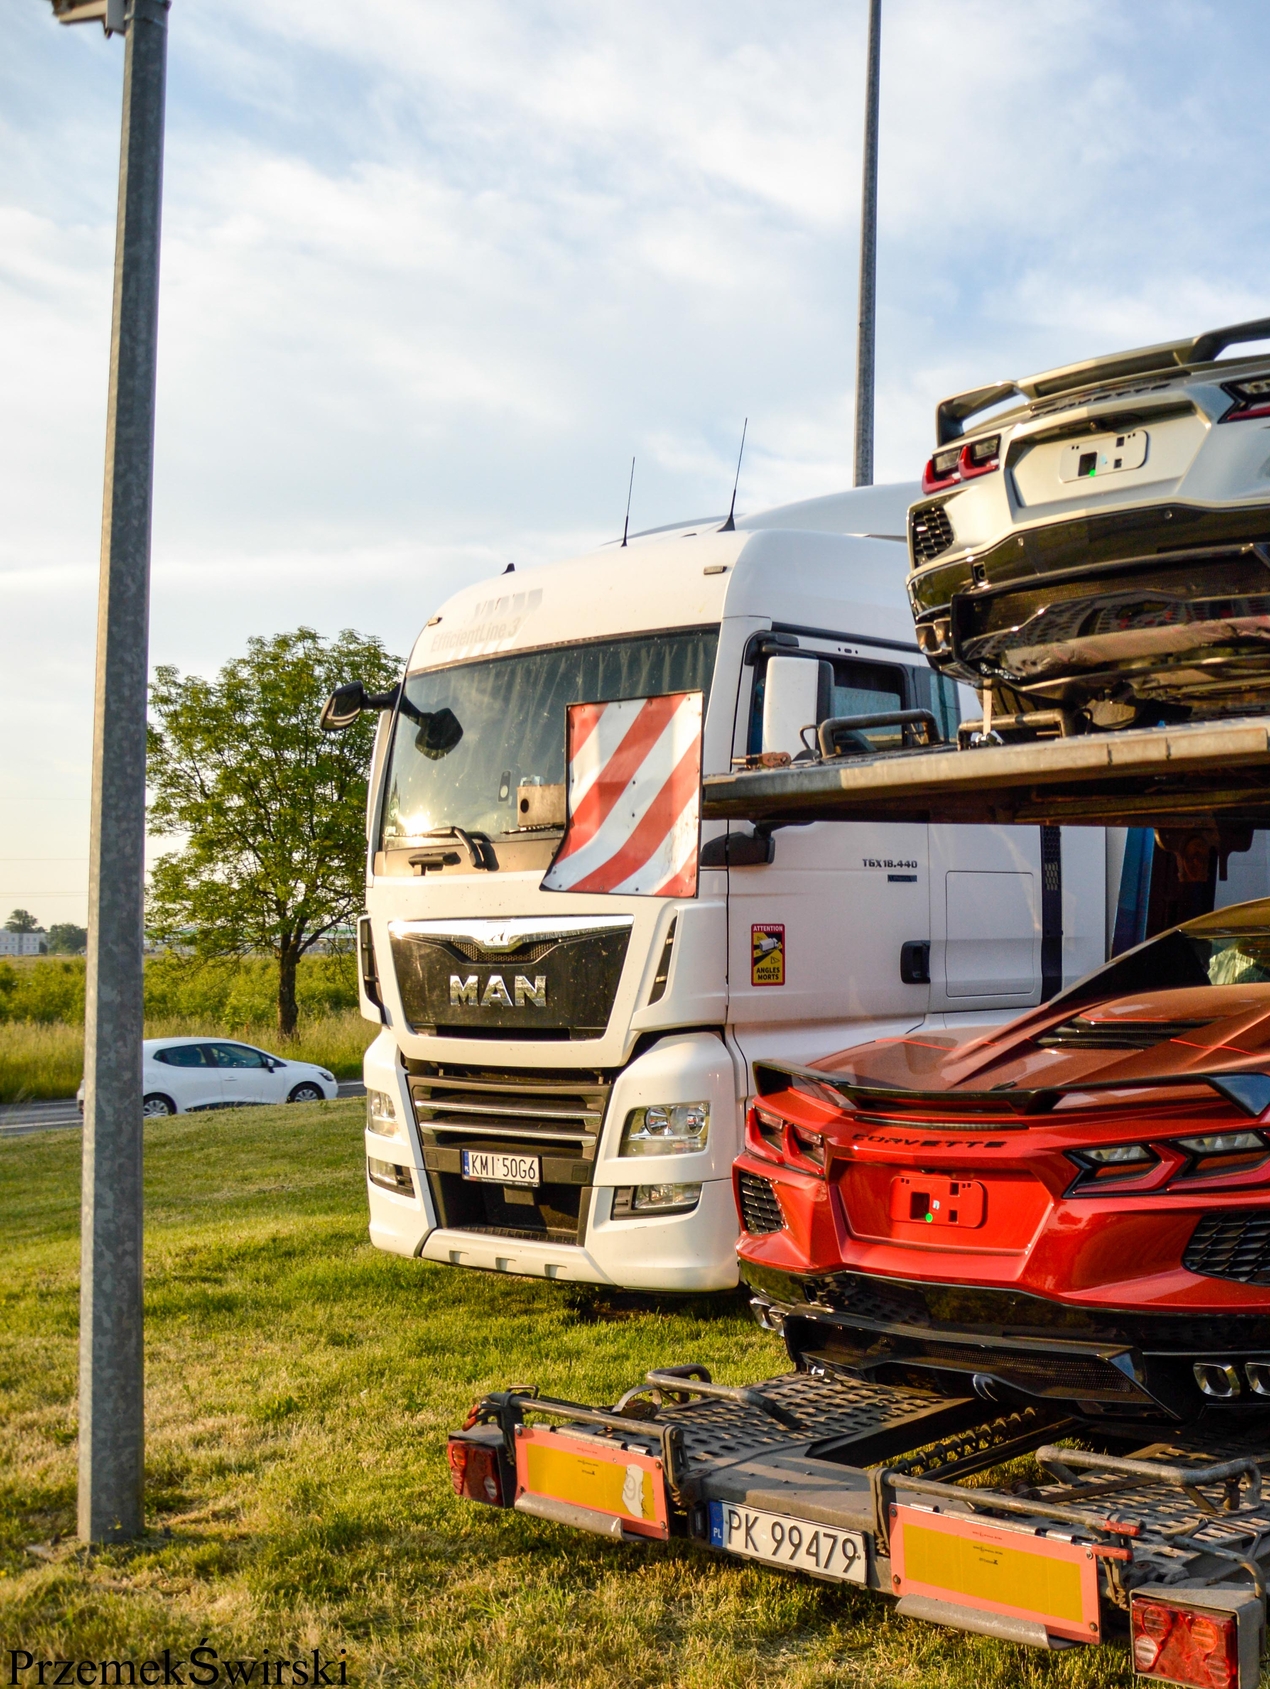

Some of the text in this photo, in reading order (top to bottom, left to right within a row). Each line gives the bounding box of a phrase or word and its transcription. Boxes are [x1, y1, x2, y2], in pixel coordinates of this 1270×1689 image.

[430, 616, 521, 653] EfficientLine 3
[756, 966, 781, 974] ANGLES
[757, 973, 780, 981] MORTS
[449, 975, 547, 1007] MAN
[851, 1133, 1008, 1149] CORVETTE
[471, 1154, 536, 1180] KMI 50G6
[713, 1527, 722, 1539] PL
[728, 1508, 858, 1574] PK 99479
